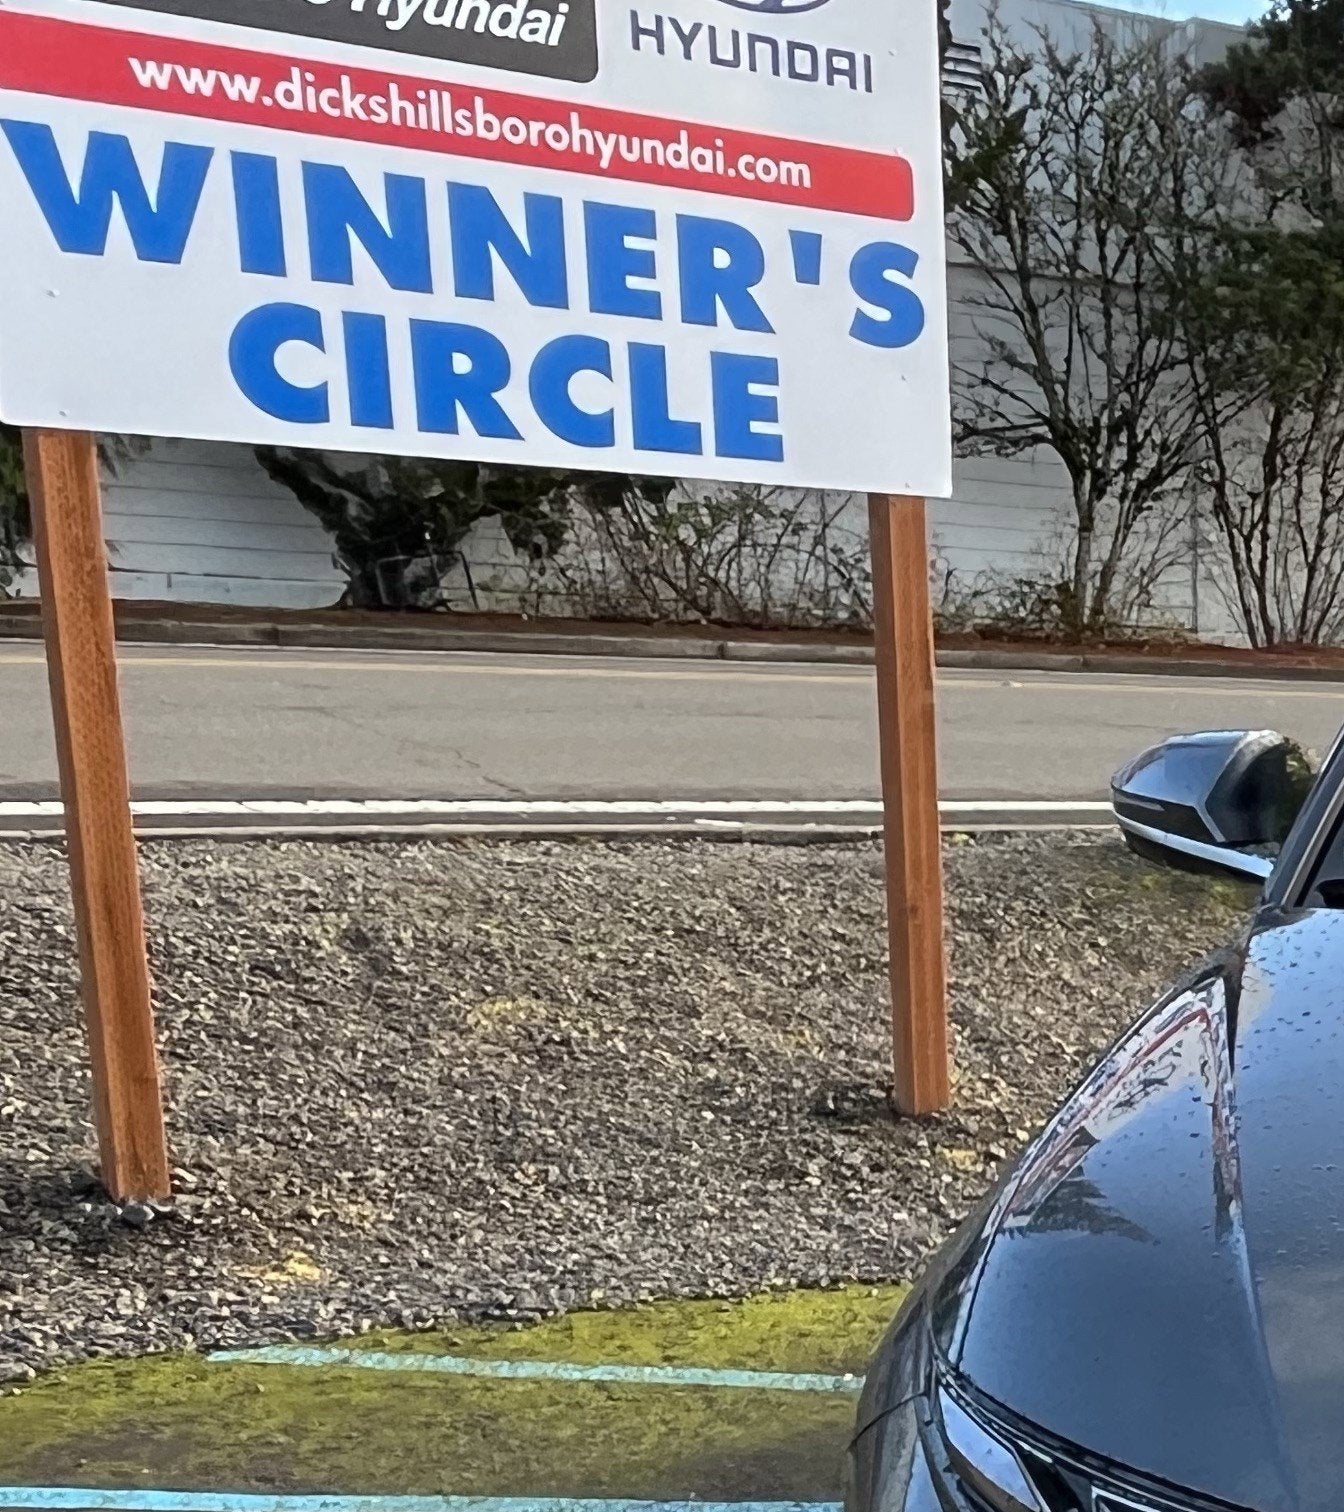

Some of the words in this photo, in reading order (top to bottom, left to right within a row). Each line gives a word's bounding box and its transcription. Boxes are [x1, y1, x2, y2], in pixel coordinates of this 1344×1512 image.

[128, 56, 812, 190] www.dickshillsborohyundai.com
[630, 9, 873, 93] HYUNDAI
[1, 117, 925, 350] WINNER'S
[228, 301, 785, 463] CIRCLE
